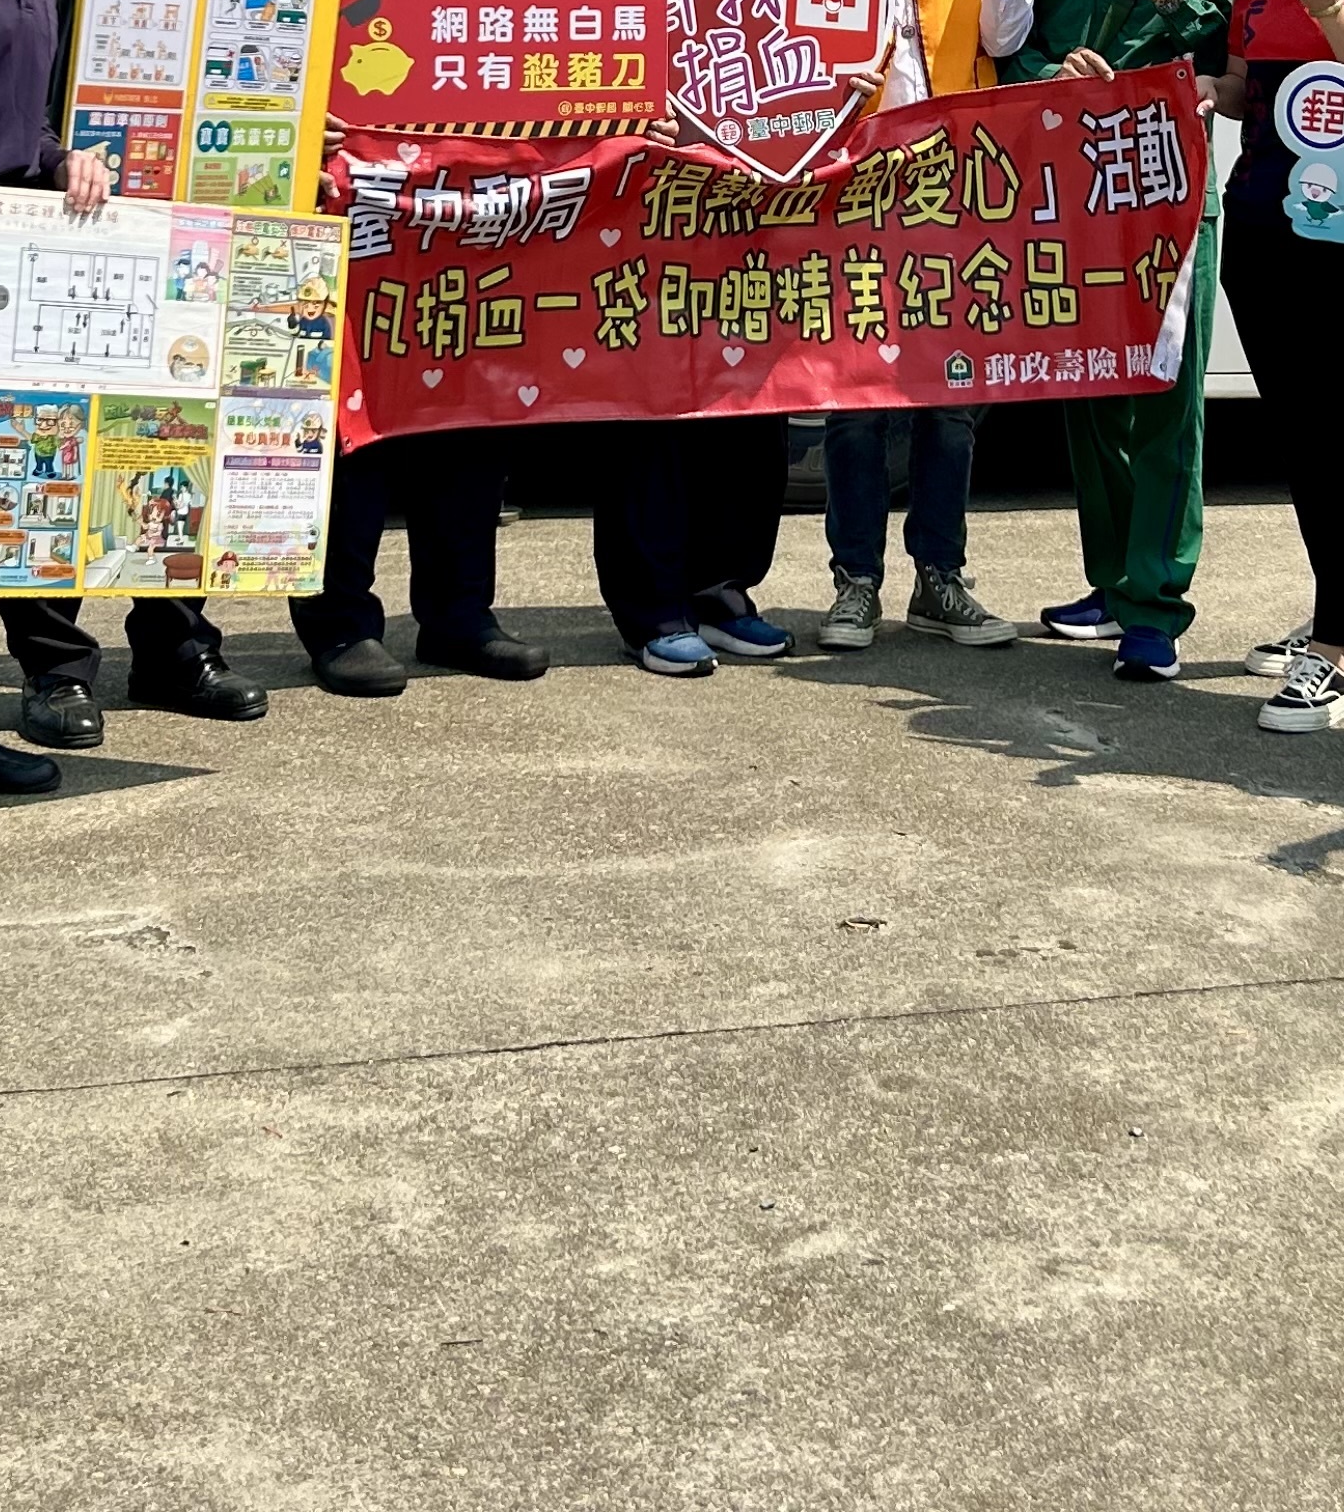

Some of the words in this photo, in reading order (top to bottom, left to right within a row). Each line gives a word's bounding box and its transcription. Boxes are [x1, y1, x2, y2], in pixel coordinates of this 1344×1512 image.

[431, 4, 647, 44] 網路無白馬
[431, 51, 647, 92] 只有殺豬刀
[676, 29, 832, 114] 捐血
[746, 109, 836, 140] 臺中郵局
[360, 234, 1182, 361] 凡捐血一袋即贈精美紀念品一份
[983, 346, 1119, 386] 郵政壽險
